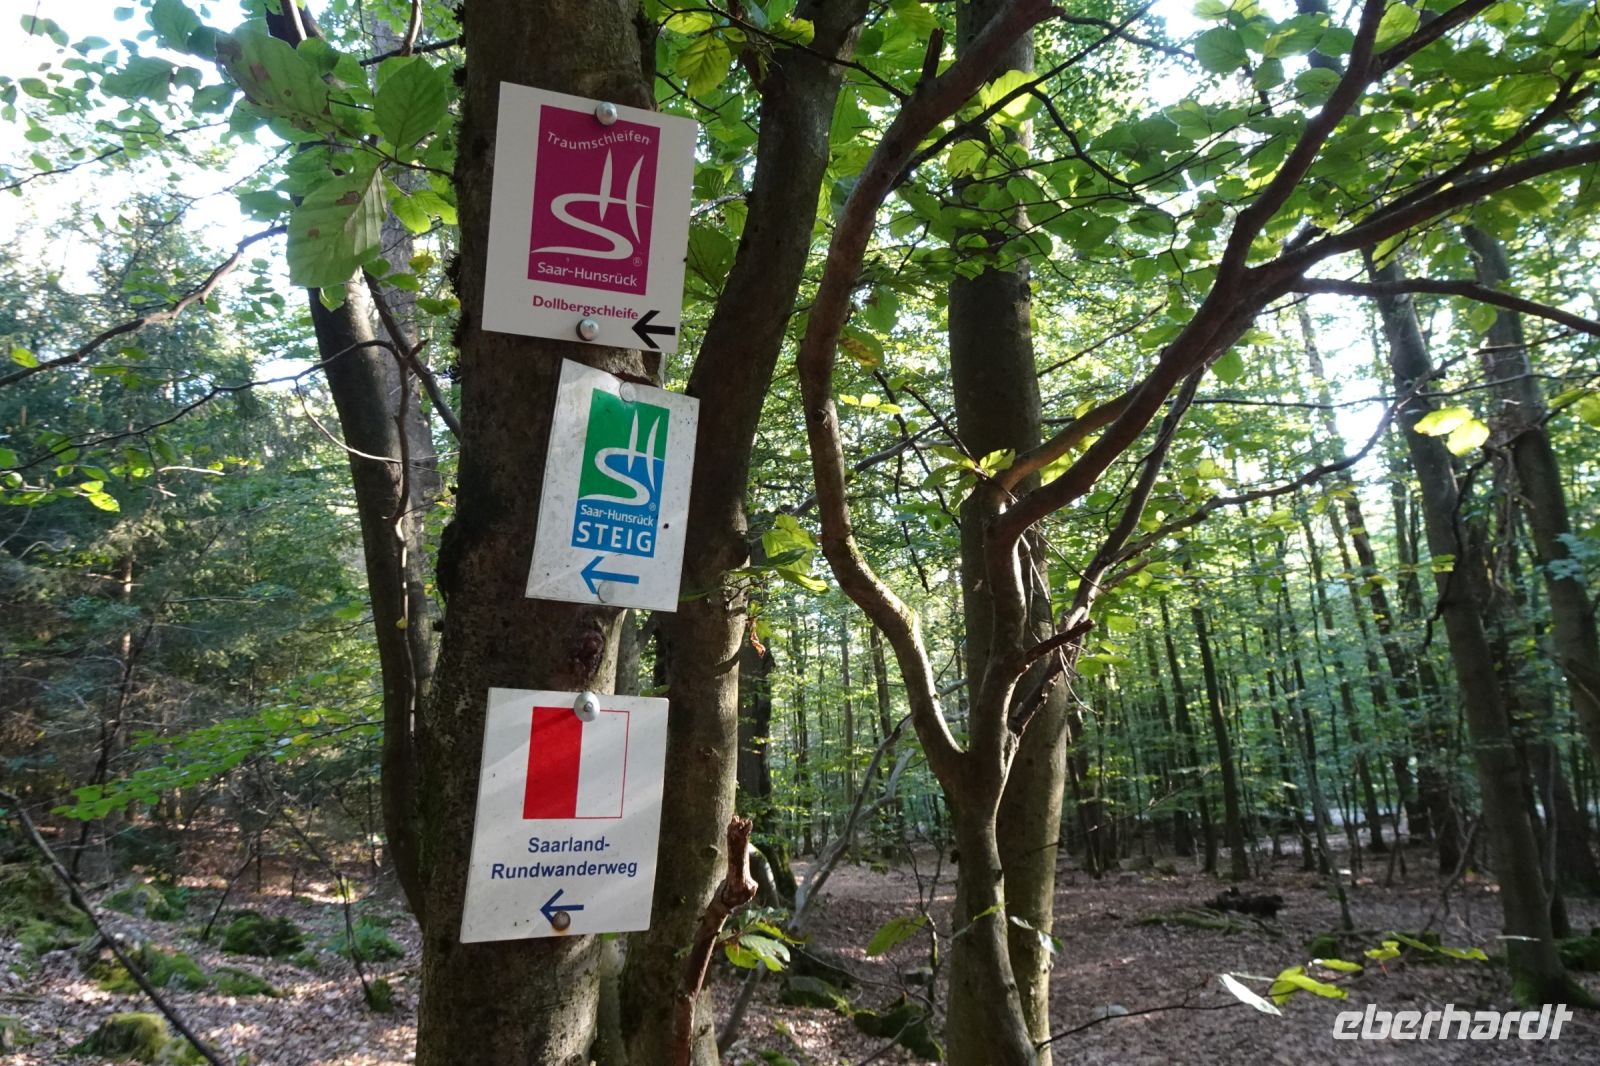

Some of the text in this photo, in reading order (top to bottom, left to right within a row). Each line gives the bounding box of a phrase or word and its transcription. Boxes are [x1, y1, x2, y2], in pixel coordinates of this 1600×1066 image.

[547, 129, 652, 150] Traumschleifen
[537, 261, 638, 287] Saar-Hunsrück
[532, 295, 639, 320] Dollbergschleife
[580, 504, 654, 527] Saar-Hunsrück
[576, 521, 652, 552] STEIG
[528, 836, 610, 853] Saarland-
[491, 861, 638, 879] Rundwanderweg
